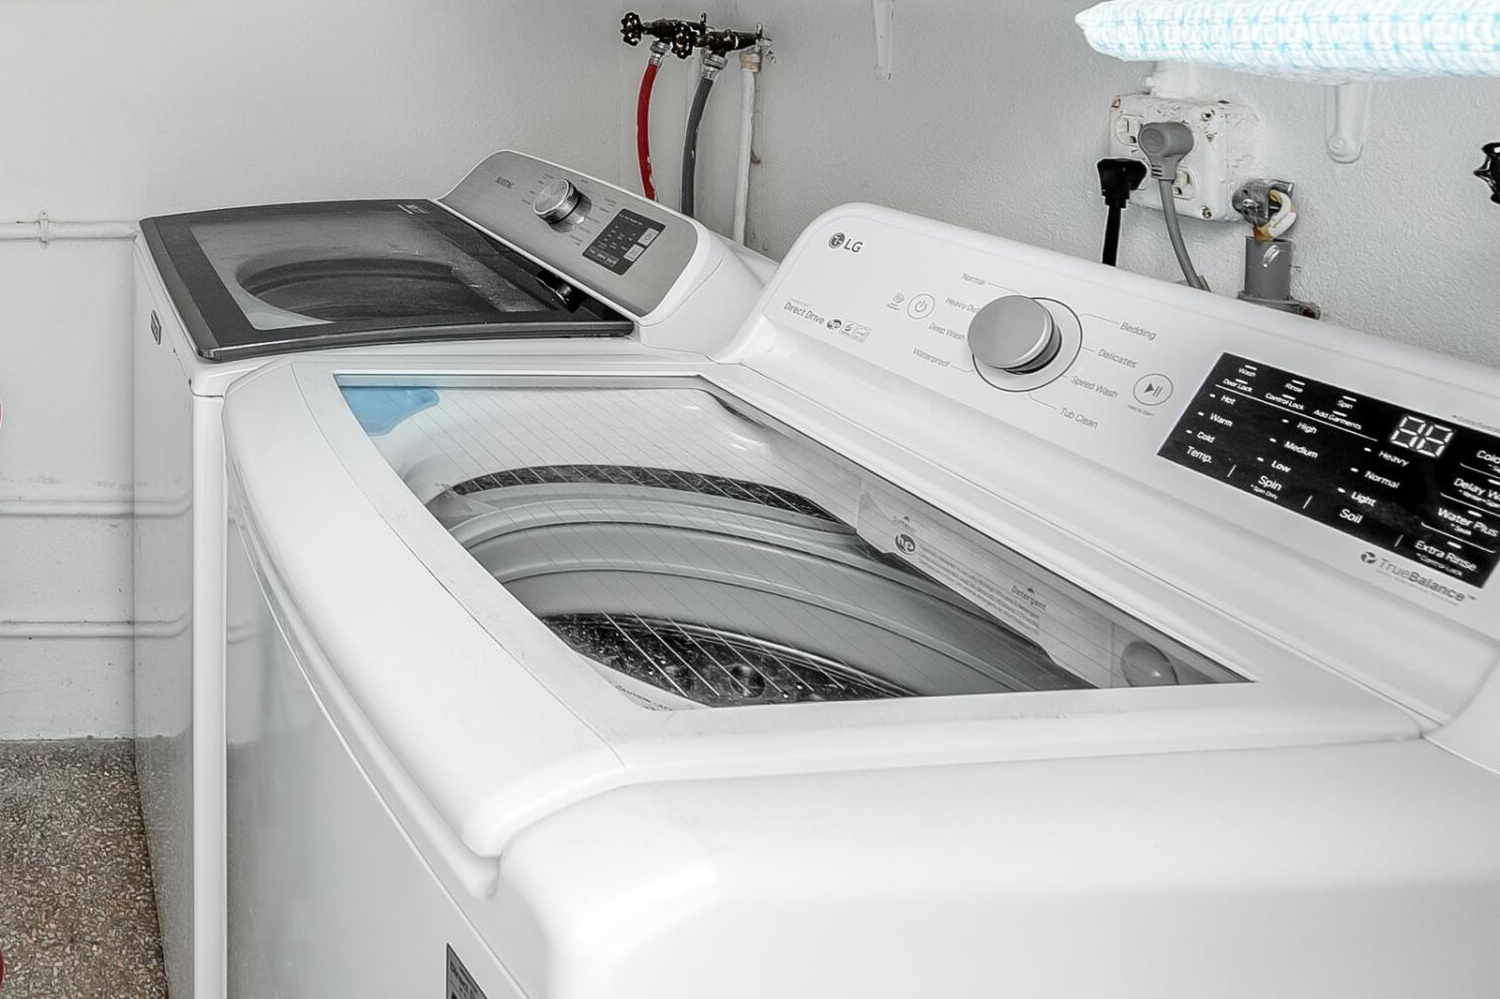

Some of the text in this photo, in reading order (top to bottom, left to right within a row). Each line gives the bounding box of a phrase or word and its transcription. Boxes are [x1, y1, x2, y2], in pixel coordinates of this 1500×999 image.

[843, 238, 864, 253] LG
[784, 301, 806, 317] Direct
[805, 310, 825, 324] Drive
[928, 322, 966, 341] Deep Wash
[1120, 321, 1156, 341] Bedding
[913, 347, 950, 367] Waterproof
[1098, 348, 1138, 368] Delicates
[1071, 375, 1118, 398] Speed Wash
[1221, 394, 1236, 405] Hot
[1060, 407, 1098, 429] Tub Clean
[1210, 413, 1233, 427] Warm
[1197, 431, 1216, 443] Cold
[1297, 422, 1317, 434] High
[1186, 445, 1213, 463] Temp.
[1284, 441, 1318, 458] Medium
[1378, 450, 1409, 467] Heavy
[1271, 460, 1291, 473] Low
[1258, 475, 1282, 491] Spin
[1365, 471, 1400, 489] Normal
[1453, 478, 1486, 496] Delay
[1351, 491, 1376, 506] Light
[1339, 509, 1363, 524] Soil
[1438, 507, 1500, 537] Water Plus
[1414, 540, 1477, 571] Extra Rinse
[1011, 585, 1047, 609] Detergent
